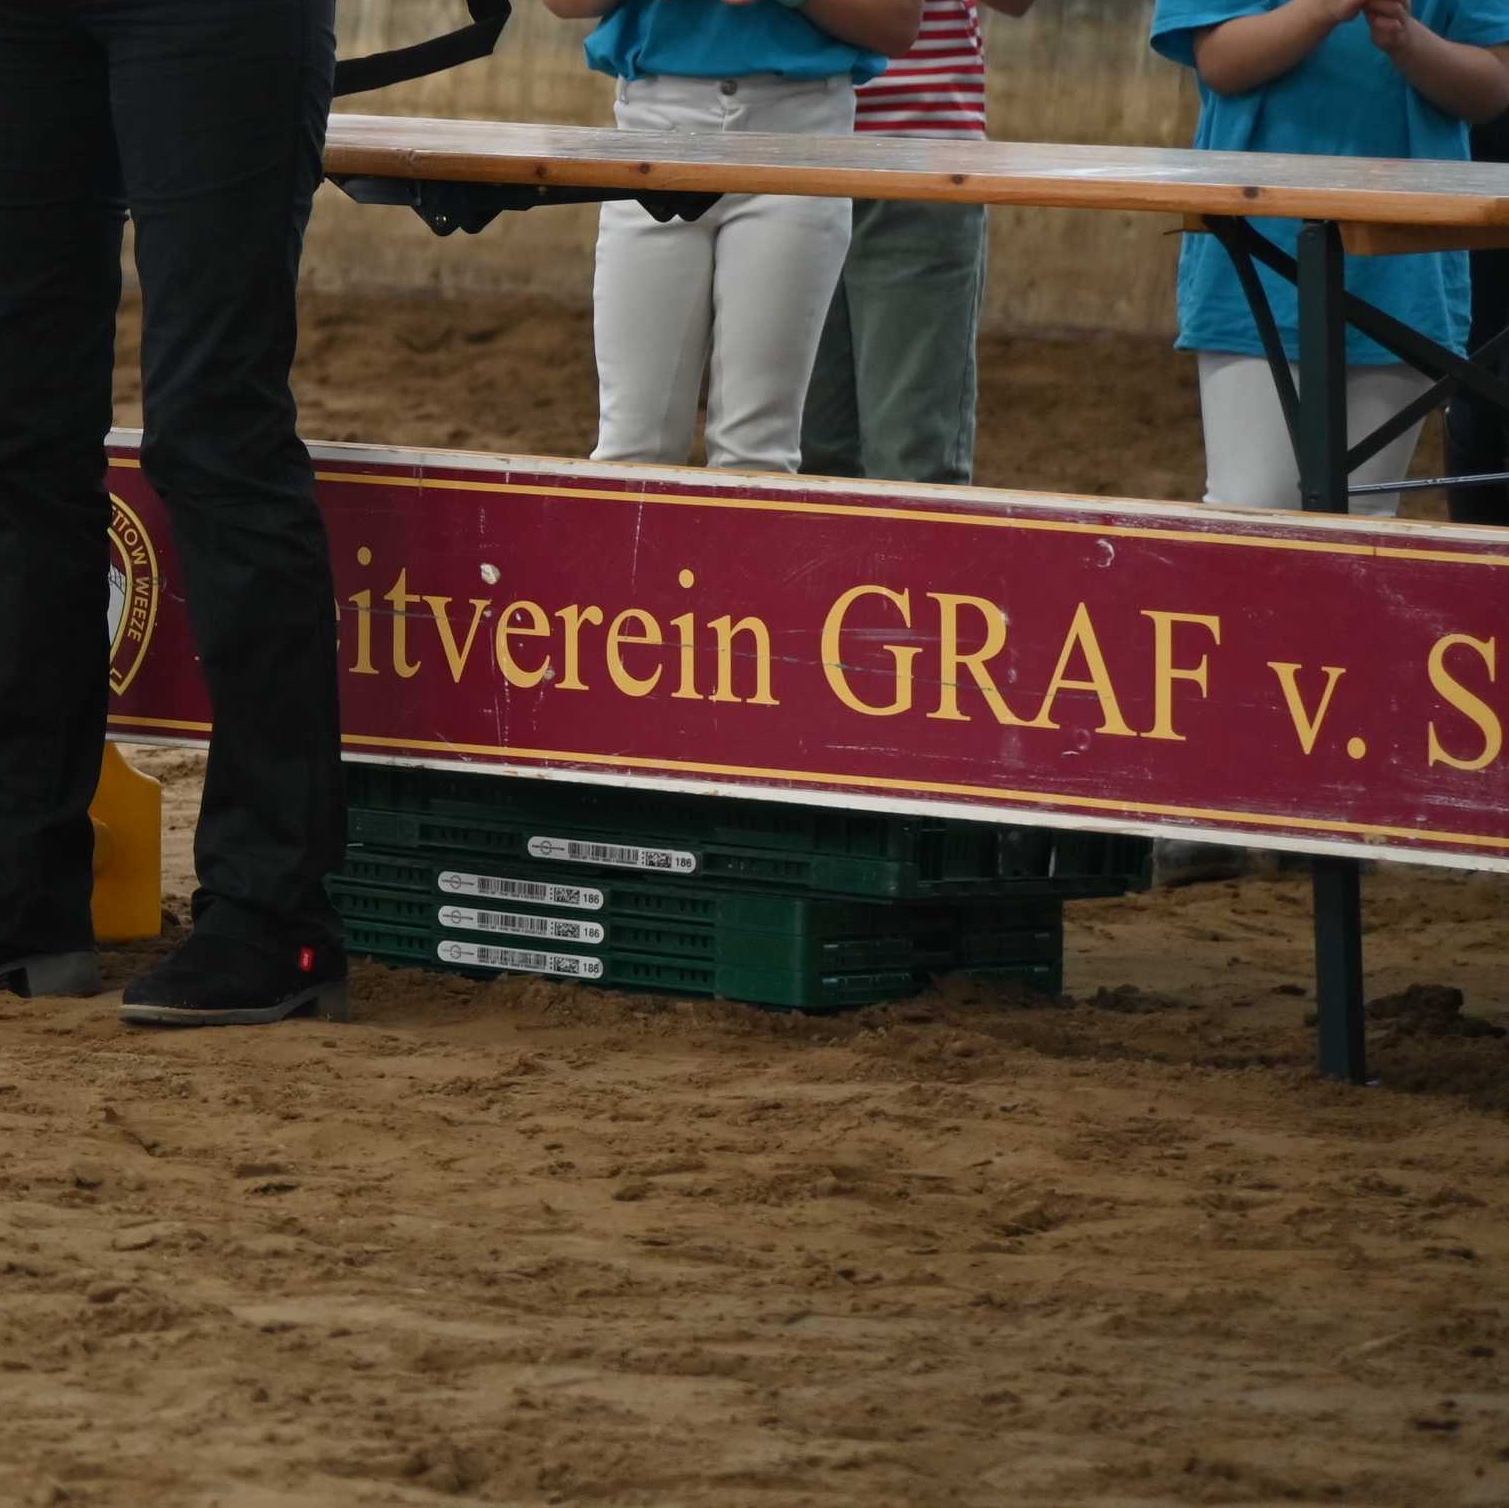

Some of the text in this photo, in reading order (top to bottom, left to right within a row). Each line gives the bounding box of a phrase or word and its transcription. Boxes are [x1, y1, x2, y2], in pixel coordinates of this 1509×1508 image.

[126, 575, 150, 643] WEEZE
[334, 545, 781, 708] itverein
[820, 583, 1221, 742] GRAF
[1266, 660, 1368, 762] v.
[674, 856, 693, 869] 186
[583, 892, 600, 905] 186
[583, 927, 600, 939] 186
